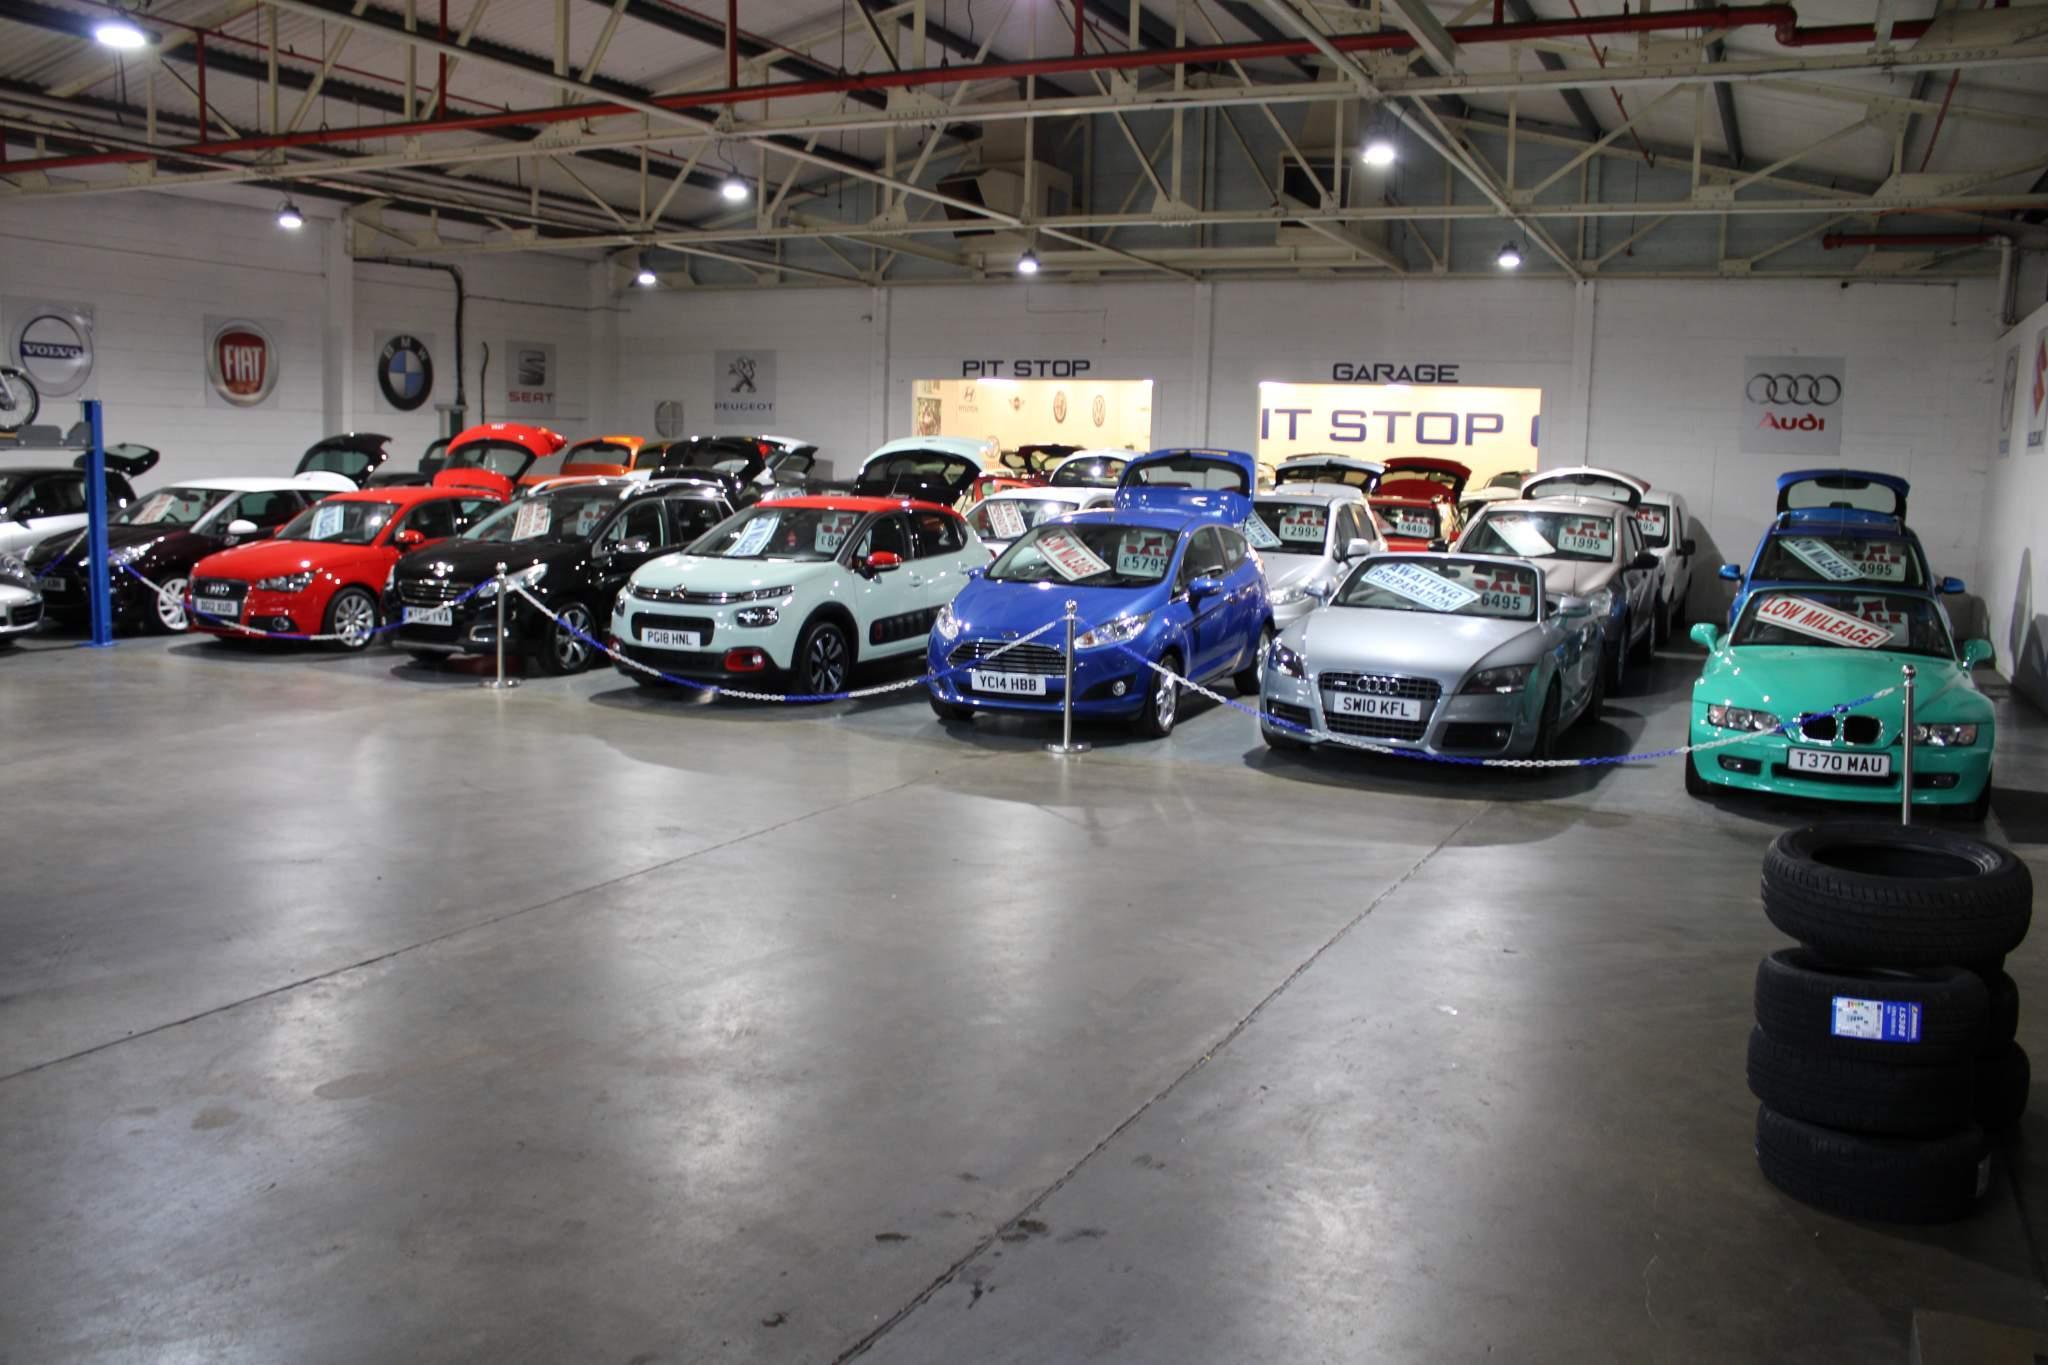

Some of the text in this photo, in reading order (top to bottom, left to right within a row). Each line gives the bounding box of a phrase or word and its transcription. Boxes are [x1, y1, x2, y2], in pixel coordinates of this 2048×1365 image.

[24, 343, 82, 358] VOLVO
[224, 344, 263, 382] FIAT
[962, 360, 1090, 377] PIT STOP
[1332, 362, 1459, 383] GARAGE
[508, 391, 554, 403] SEAT
[714, 402, 773, 411] PEUGEOT
[1329, 409, 1504, 446] STOP
[1853, 562, 1892, 577] 4995
[1372, 571, 1452, 608] PREPARATION
[1388, 562, 1463, 600] AWAITING
[1473, 592, 1521, 610] 6495
[1761, 597, 1880, 647] LOW MILEAGE
[647, 631, 693, 646] PG18 HNL
[980, 675, 1037, 691] YC14 HBB
[1343, 697, 1410, 717] SW10 KFL
[1797, 752, 1883, 773] T370 MAU
